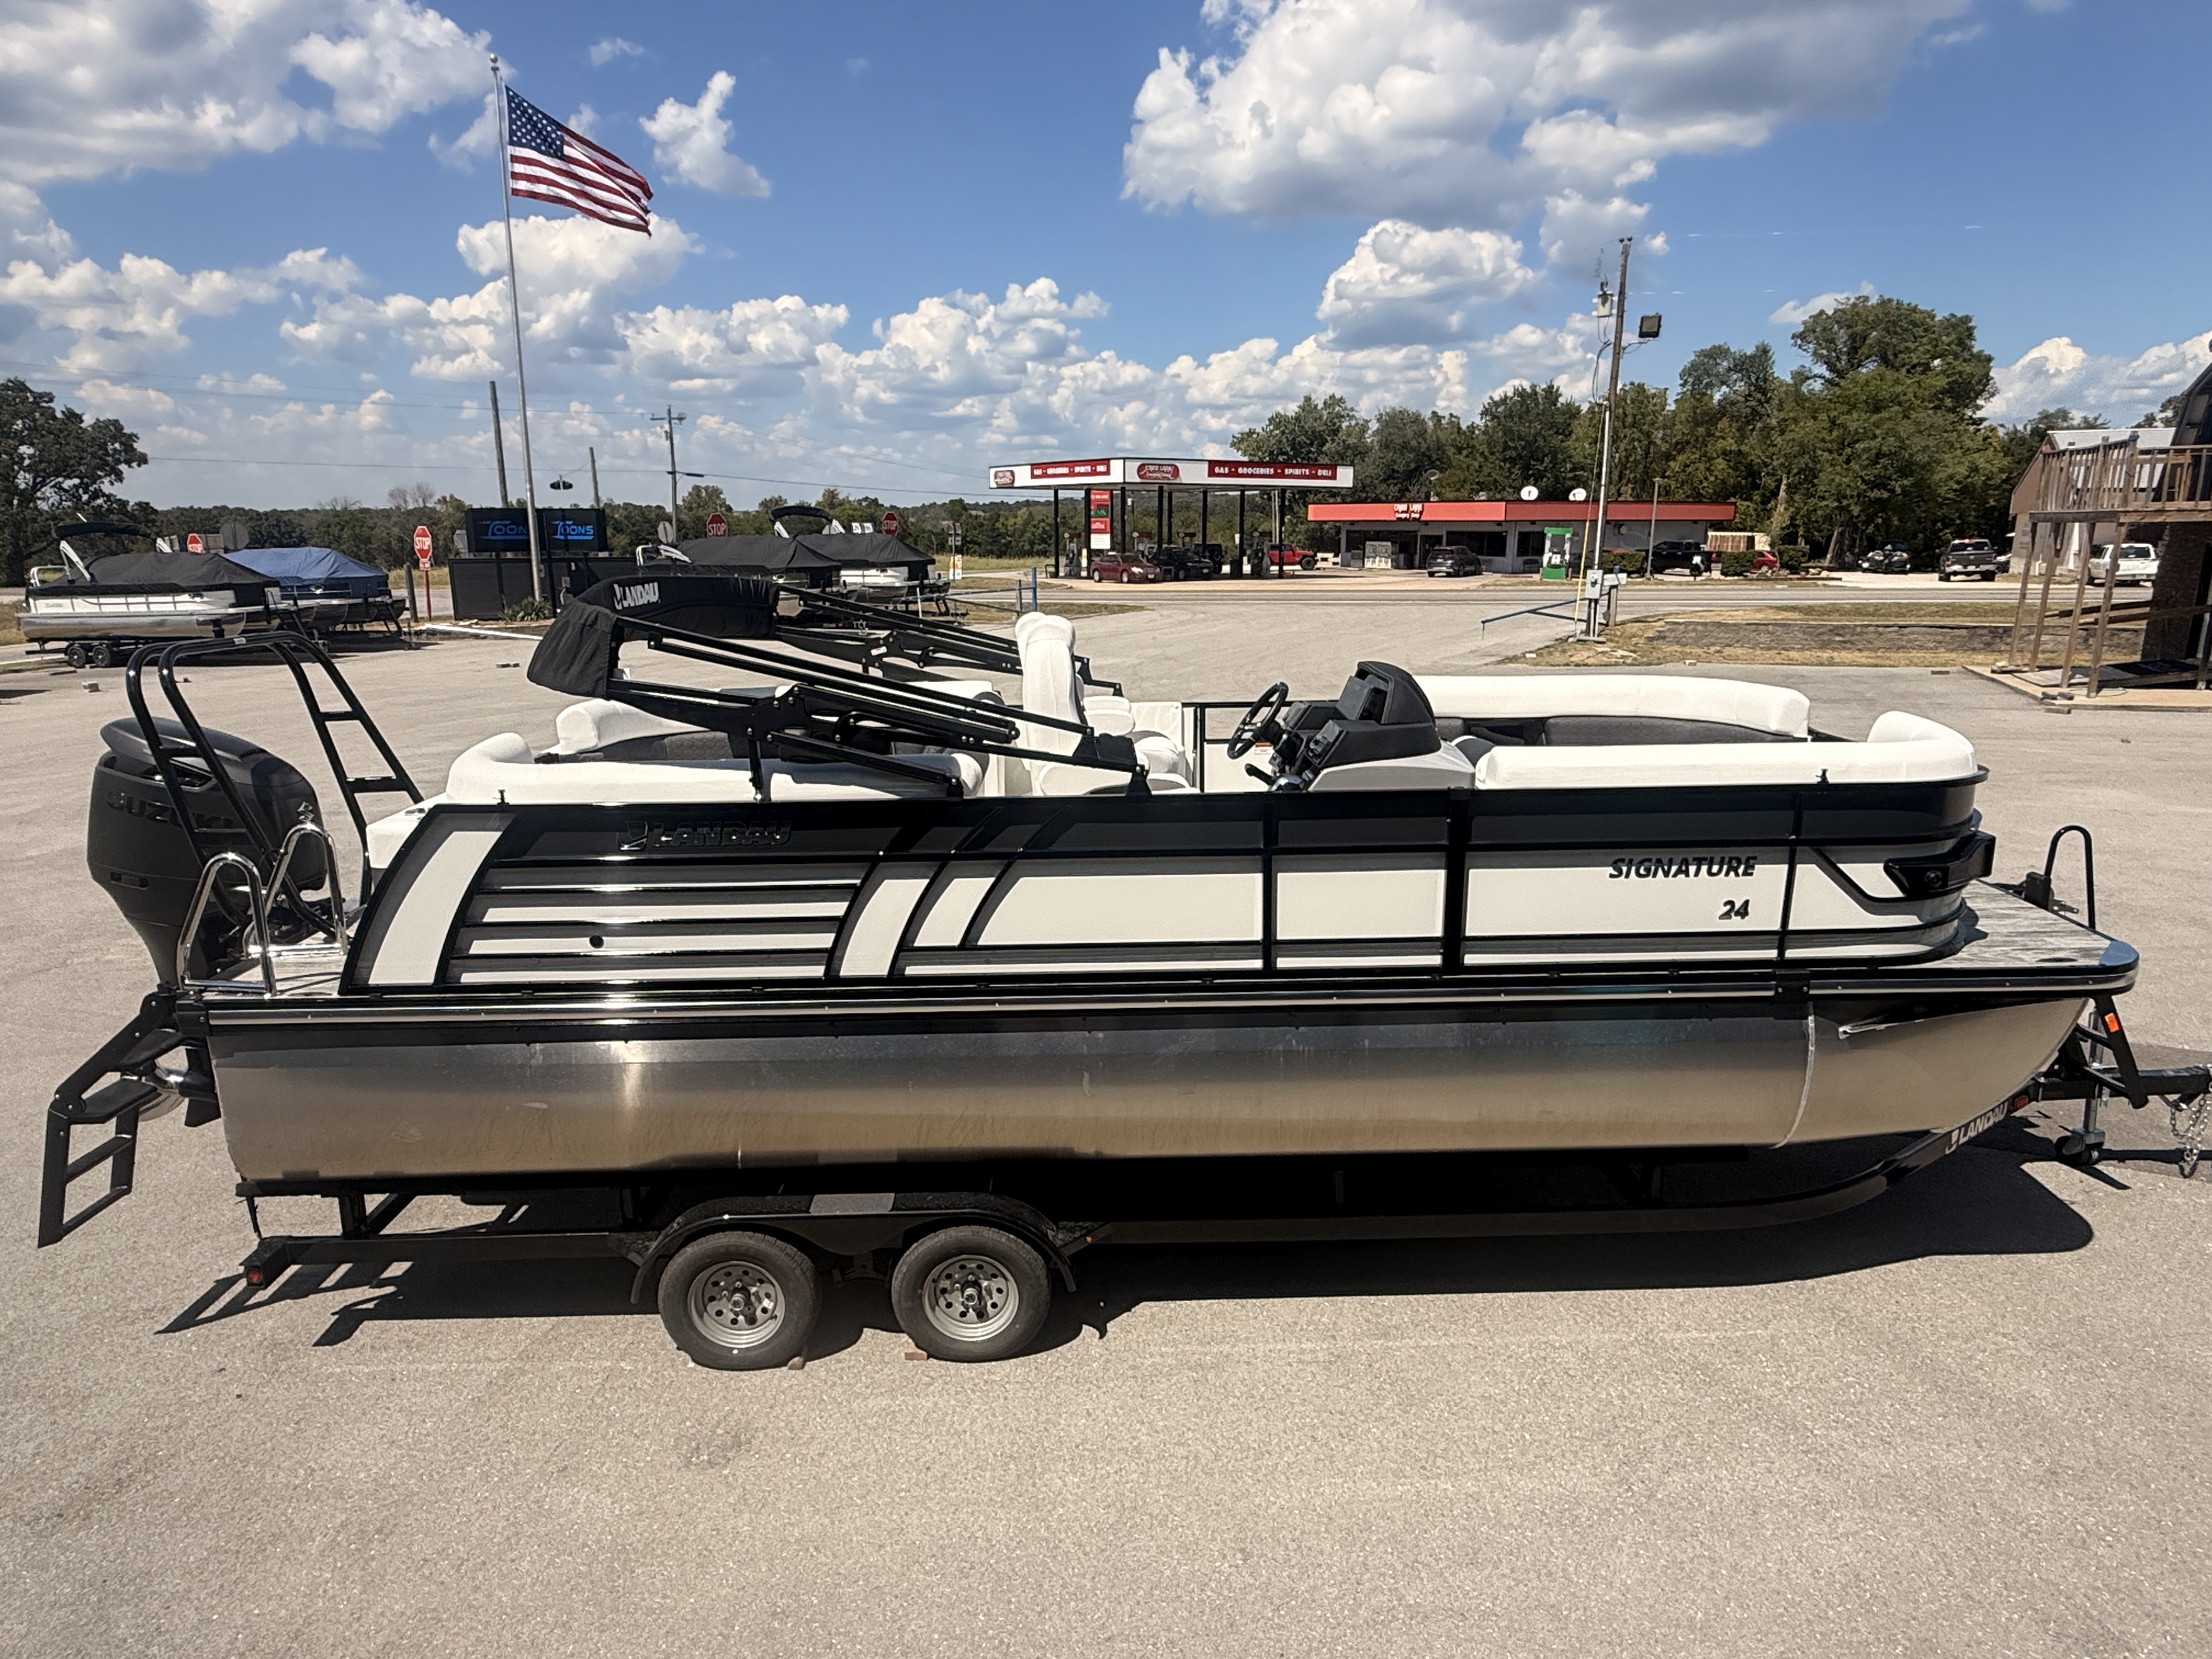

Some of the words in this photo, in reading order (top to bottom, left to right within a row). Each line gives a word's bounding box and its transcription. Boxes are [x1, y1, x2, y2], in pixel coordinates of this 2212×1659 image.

[1238, 467, 1274, 475] GROCERIES
[479, 520, 528, 540] TOON
[709, 523, 726, 535] STOP
[883, 520, 897, 531] STOP
[416, 537, 430, 550] STOP
[622, 582, 659, 607] LANDAU
[652, 821, 792, 846] LANDAU
[1609, 856, 1758, 879] SIGNATURE
[1718, 899, 1750, 921] 24
[1959, 1101, 2009, 1146] LANDAU
